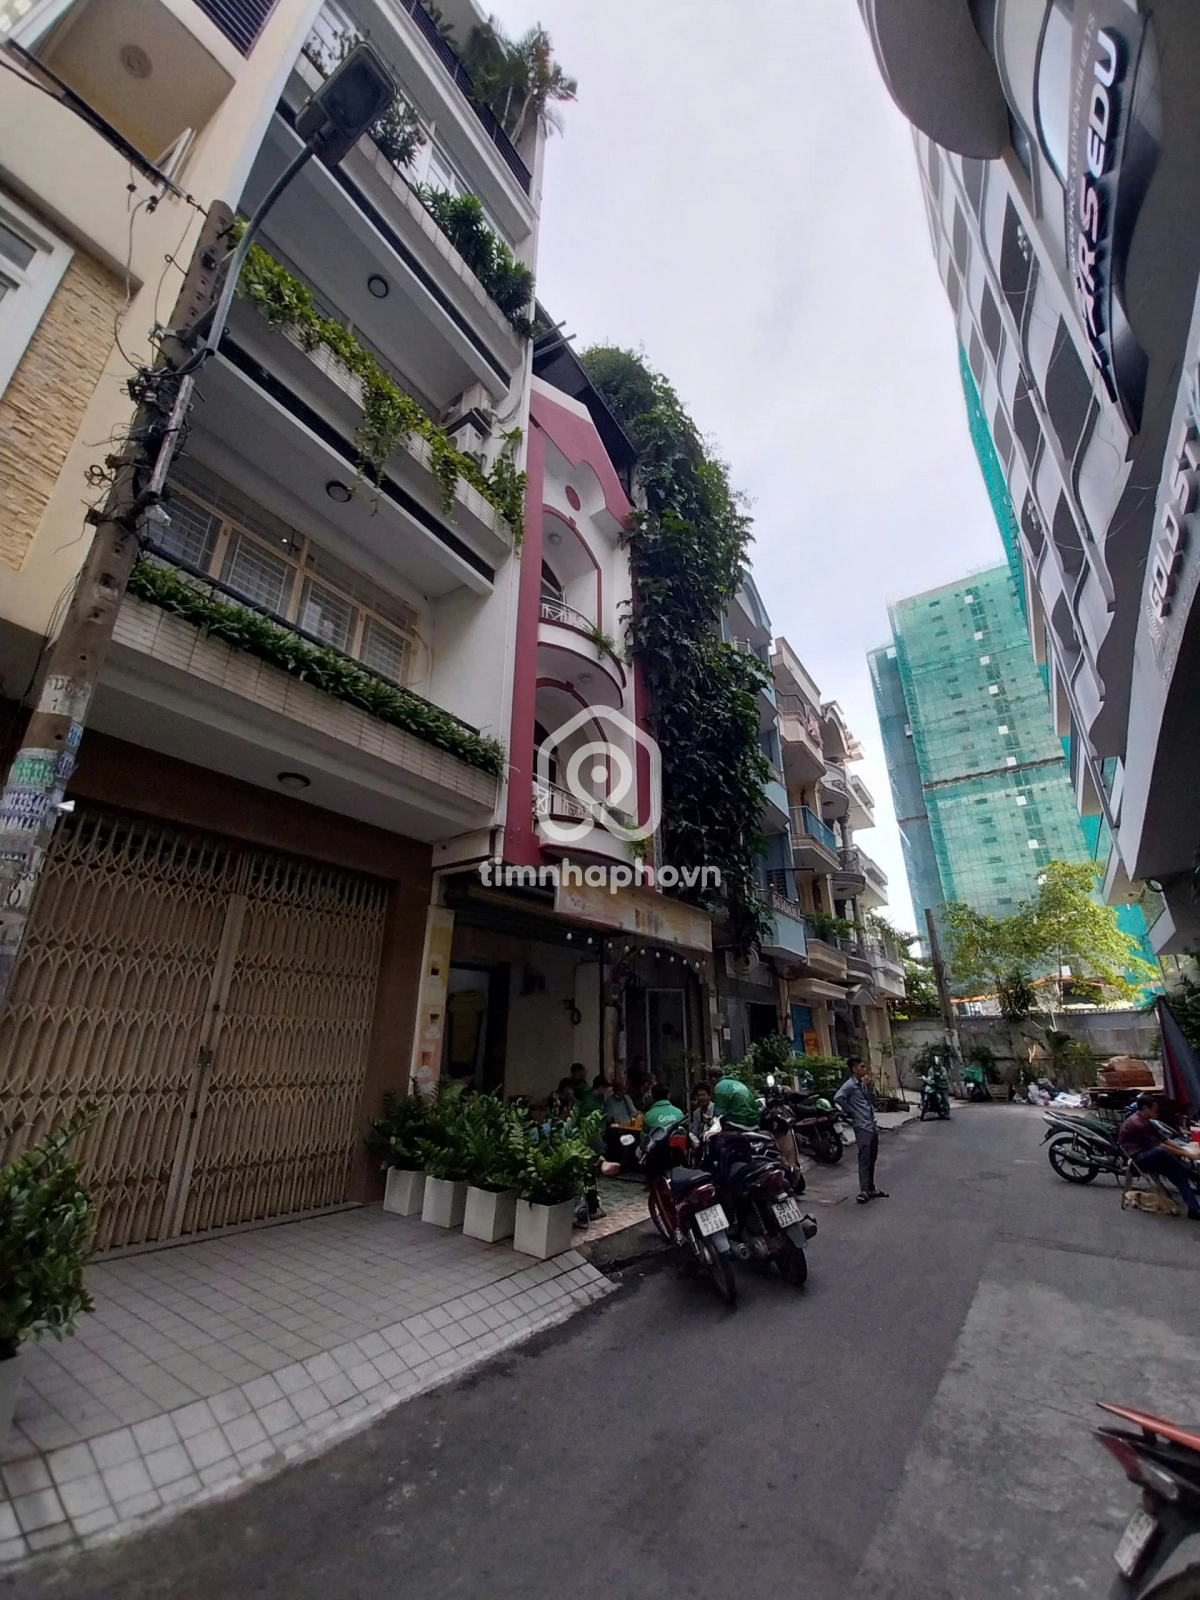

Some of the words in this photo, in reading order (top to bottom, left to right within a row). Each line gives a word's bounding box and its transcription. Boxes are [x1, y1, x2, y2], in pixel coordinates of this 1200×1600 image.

[1079, 12, 1096, 67] IELTS
[1086, 29, 1118, 179] EDU
[1147, 500, 1182, 624] GOLD
[657, 1113, 677, 1123] Grab
